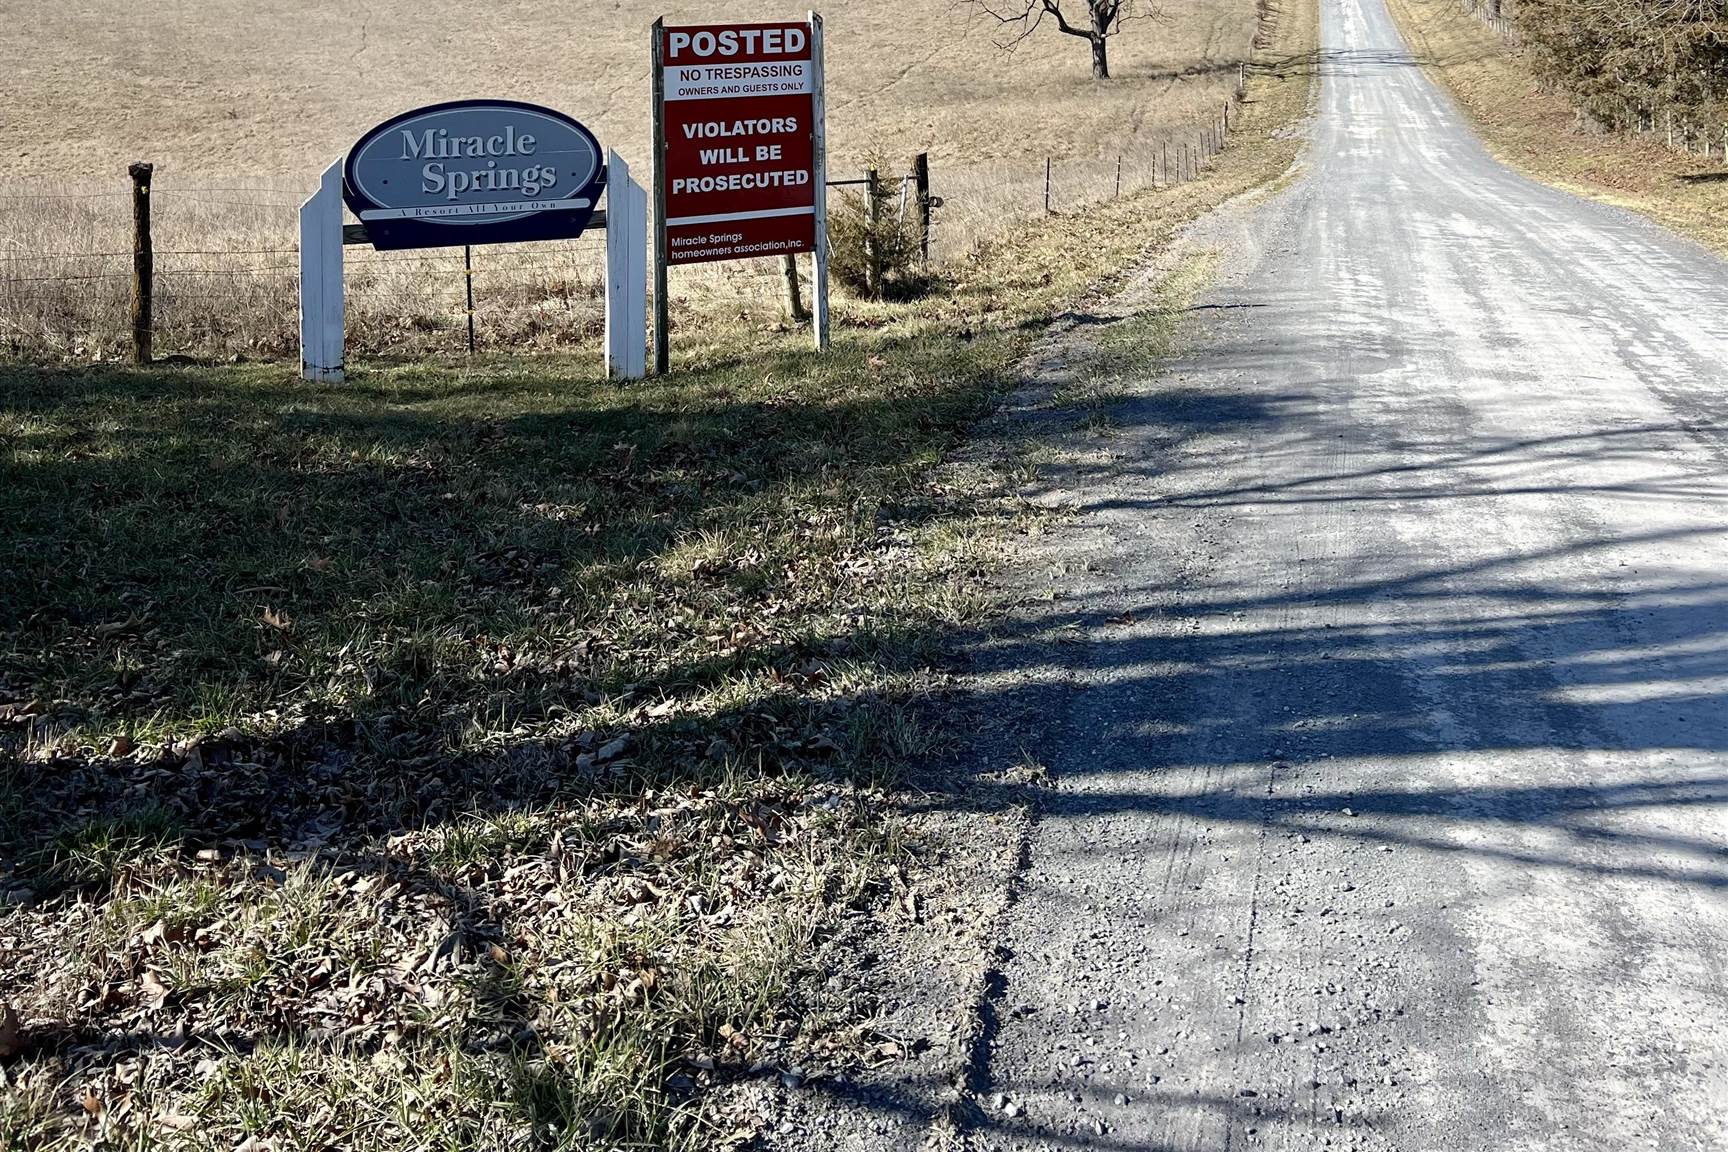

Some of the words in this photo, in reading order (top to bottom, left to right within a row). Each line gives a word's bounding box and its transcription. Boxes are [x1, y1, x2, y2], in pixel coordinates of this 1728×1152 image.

[670, 28, 805, 58] POSTED
[680, 69, 701, 81] NO
[705, 65, 802, 80] TRESPASSING
[678, 86, 719, 96] OWNERS
[722, 85, 740, 93] AND
[743, 83, 779, 93] GUESTS
[781, 82, 804, 91] ONLY
[683, 117, 797, 139] VIOLATORS
[400, 125, 536, 160] Miracle
[700, 147, 749, 165] WILL
[756, 145, 781, 161] BE
[422, 161, 557, 200] Springs
[672, 170, 809, 194] PROSECUTED
[398, 208, 407, 216] A
[416, 208, 460, 216] Resort
[466, 205, 486, 213] All
[493, 204, 524, 212] Your
[532, 201, 556, 209] Own
[671, 235, 707, 247] Miracle
[709, 233, 743, 244] Springs
[671, 247, 732, 259] homeowners
